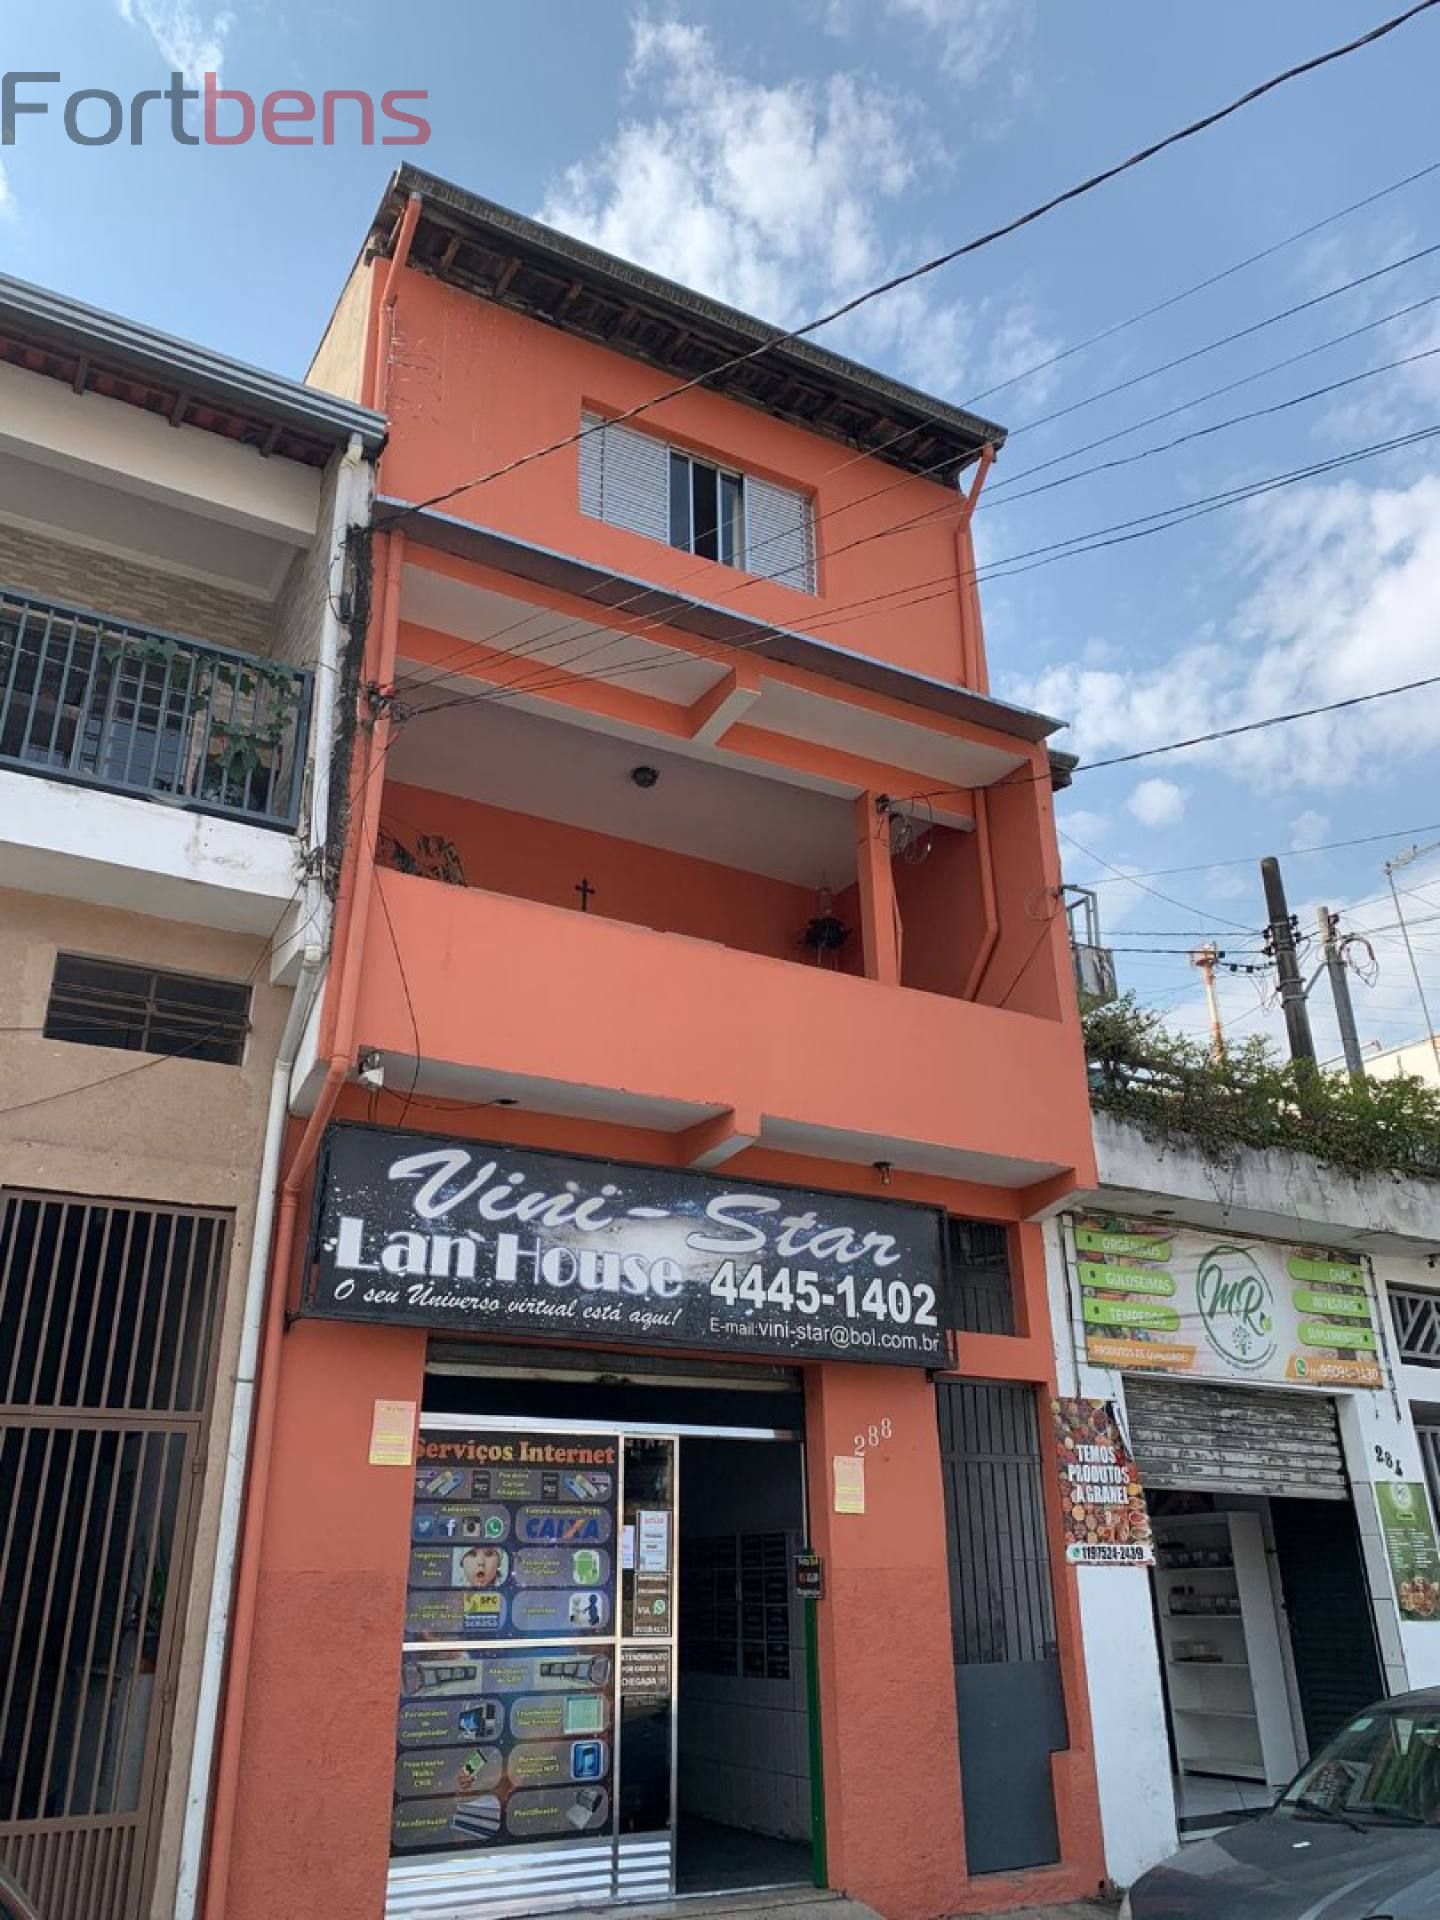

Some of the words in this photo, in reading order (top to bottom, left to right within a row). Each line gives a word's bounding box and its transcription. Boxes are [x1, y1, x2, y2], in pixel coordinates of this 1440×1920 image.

[686, 1194, 901, 1266] Star
[334, 1216, 477, 1279] Lan
[495, 1232, 685, 1298] House
[334, 1279, 356, 1301] O
[362, 1288, 399, 1304] seu
[407, 1283, 501, 1313] Universo
[508, 1296, 577, 1319] virtual
[582, 1302, 623, 1323] está
[710, 1259, 938, 1327] 4445-1402
[518, 1440, 616, 1465] Internet
[853, 1417, 892, 1457] 288
[1076, 1444, 1116, 1464] TEMOS
[1067, 1464, 1130, 1484] PRODUTOS
[525, 1517, 600, 1538] CAIXA
